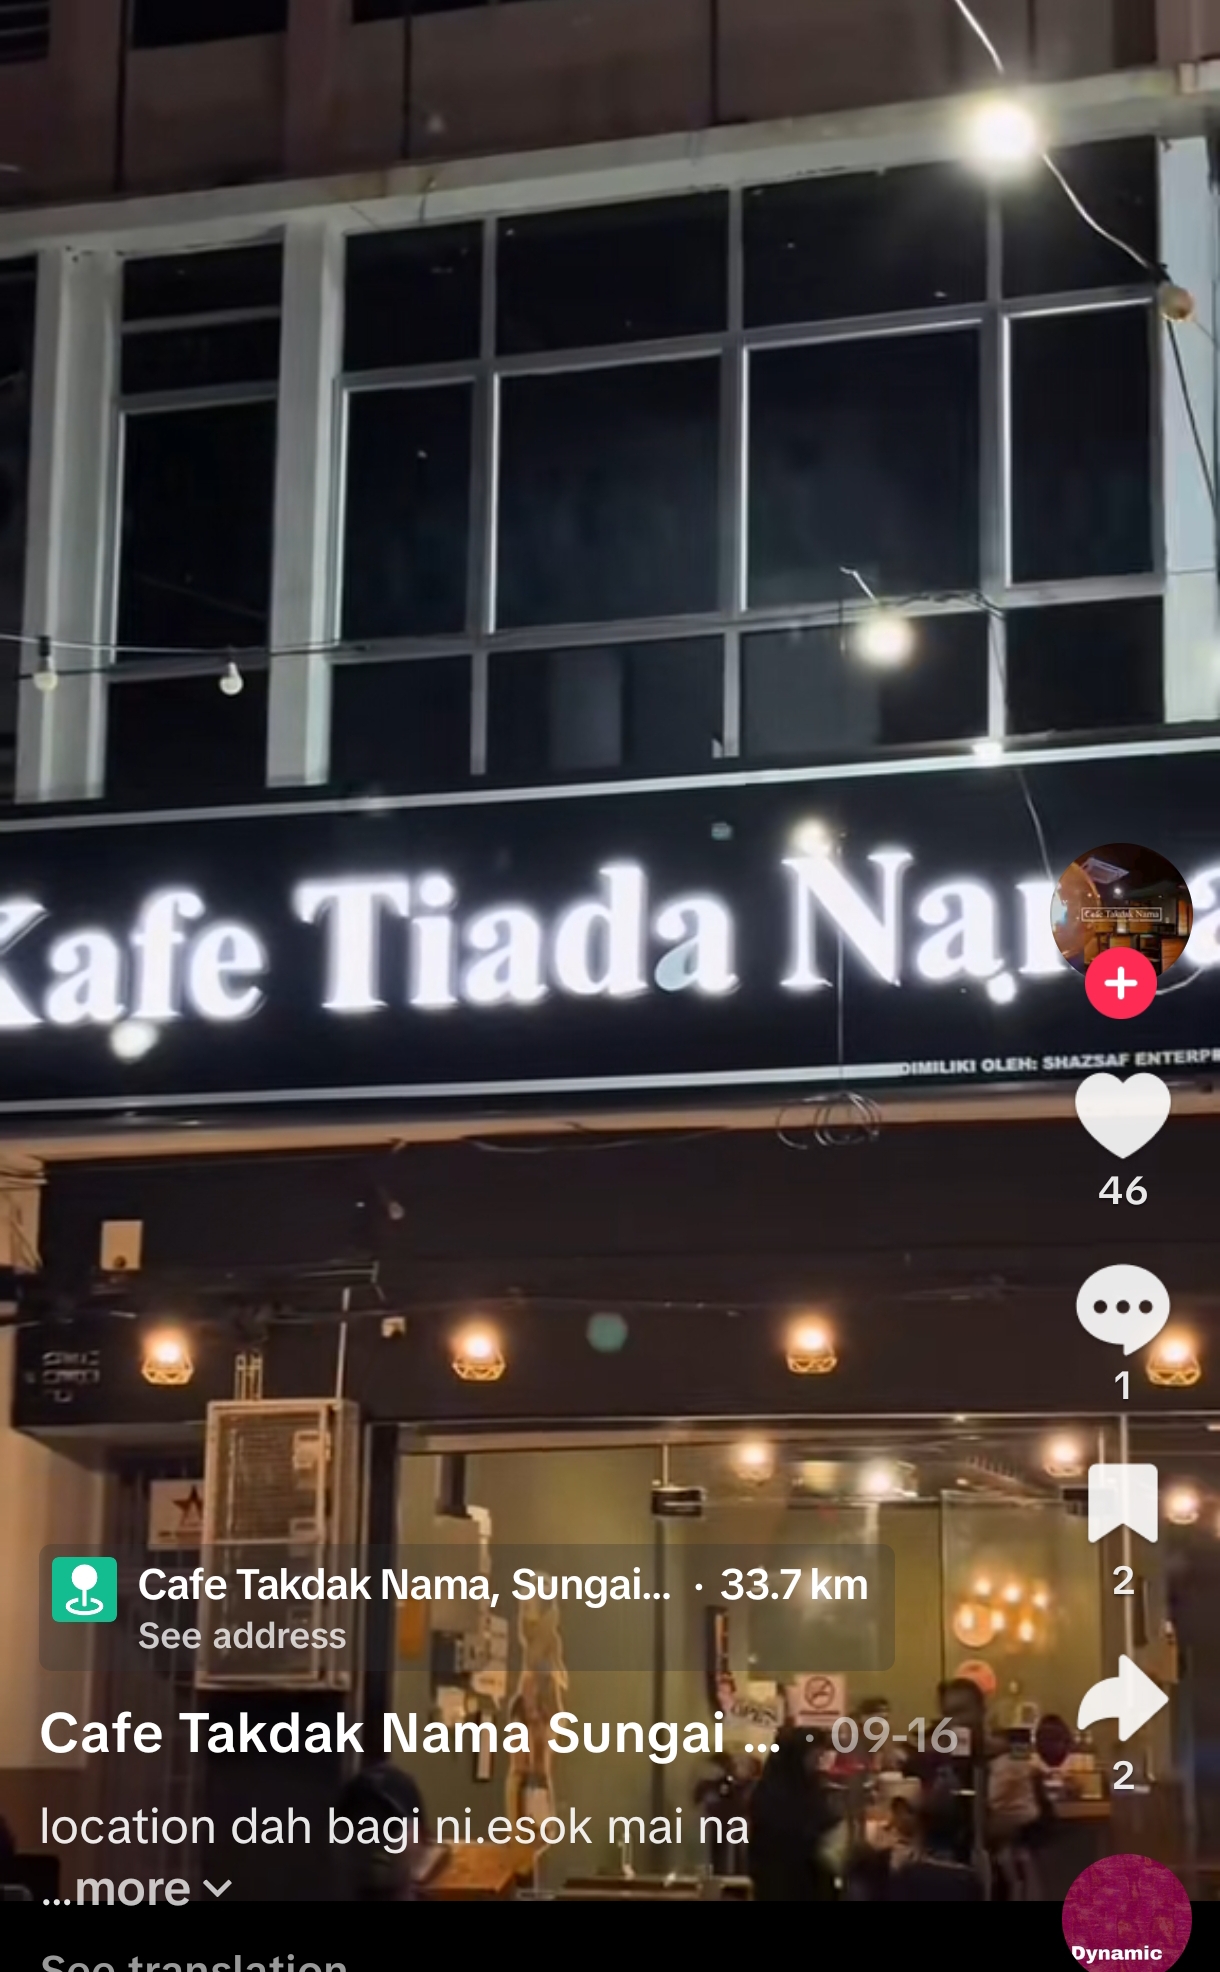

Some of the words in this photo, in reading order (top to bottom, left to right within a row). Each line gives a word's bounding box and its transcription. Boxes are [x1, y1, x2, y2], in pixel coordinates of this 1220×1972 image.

[295, 862, 740, 1011] Tiada
[900, 1058, 977, 1077] DIMILIKI
[980, 1055, 1039, 1073] OLEH:
[1041, 1050, 1131, 1071] SHAZSAF
